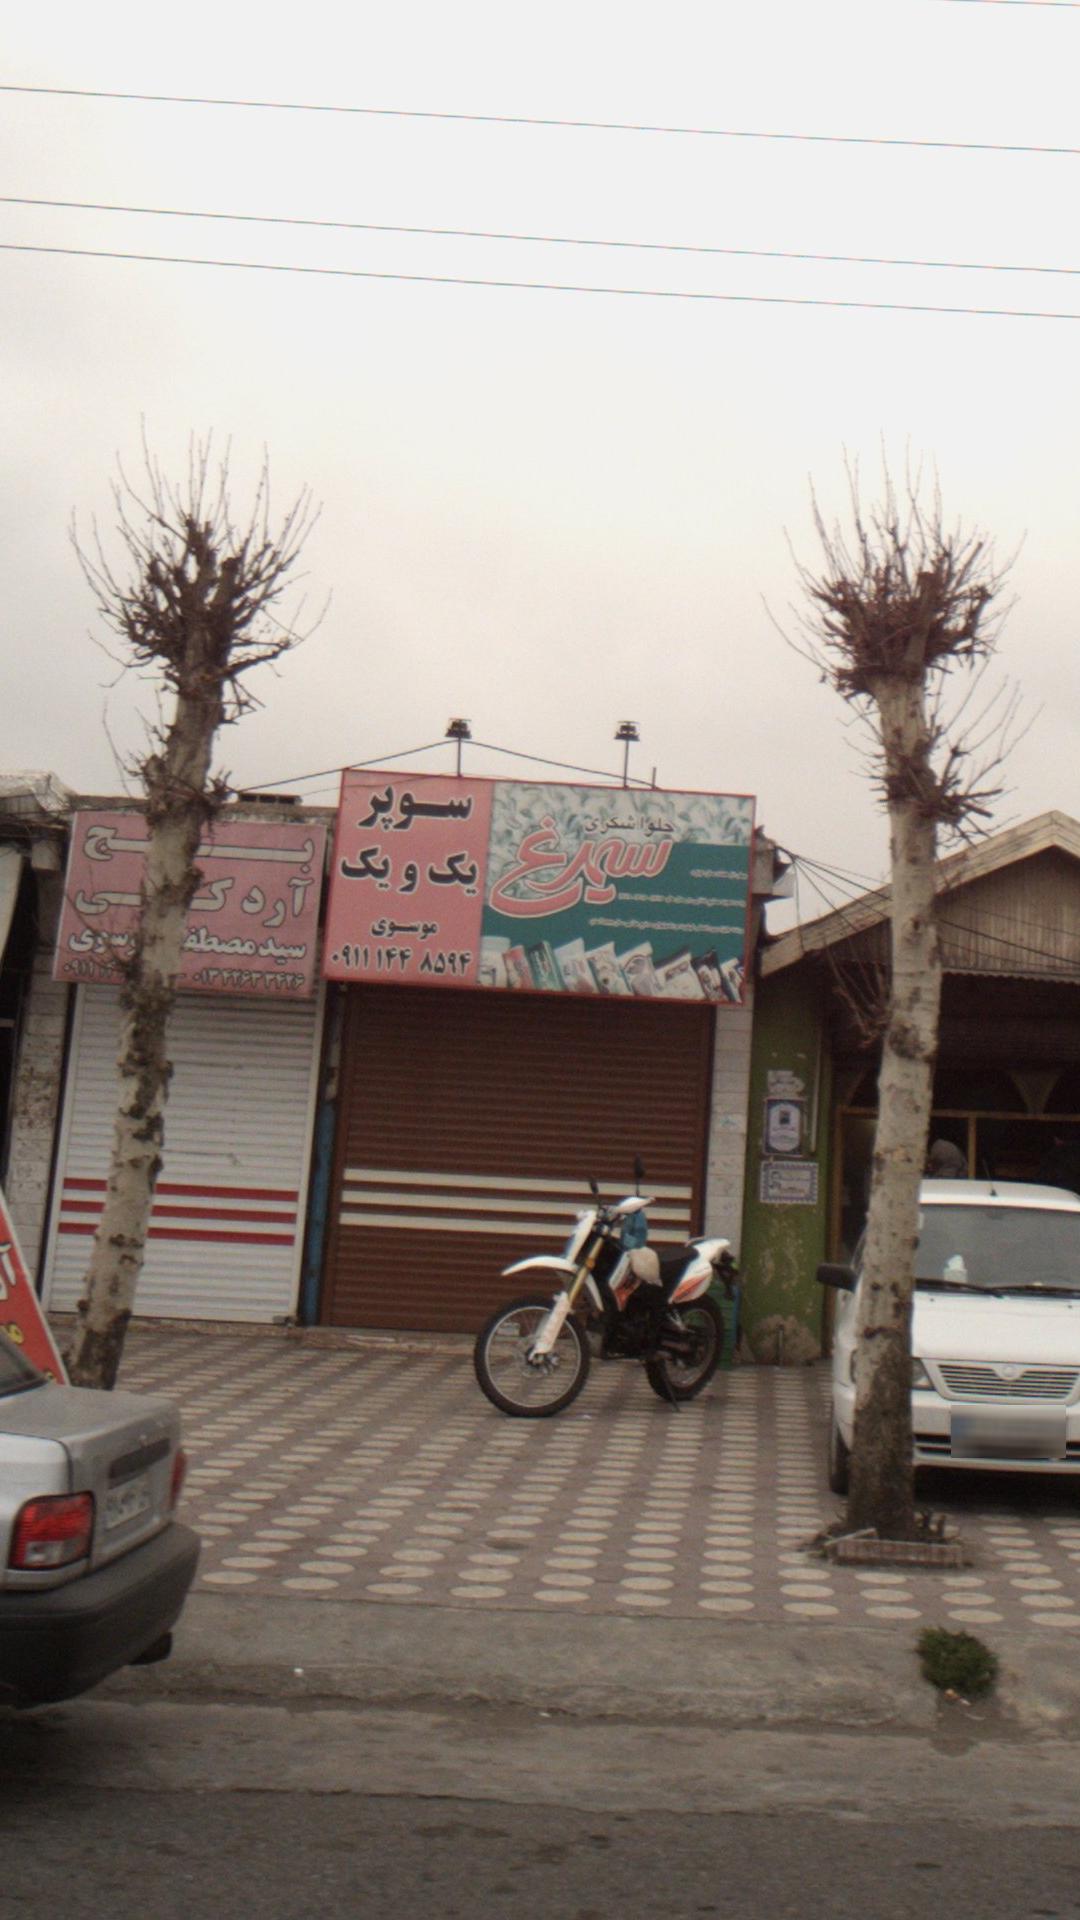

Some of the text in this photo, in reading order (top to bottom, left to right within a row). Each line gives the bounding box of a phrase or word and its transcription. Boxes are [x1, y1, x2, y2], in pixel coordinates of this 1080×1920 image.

[358, 785, 473, 830] سوپر
[341, 845, 478, 895] یک و یک
[488, 816, 674, 918] سیمرغ
[184, 927, 255, 956] مصطف
[371, 918, 438, 940] موسوی
[258, 932, 306, 964] سید
[332, 945, 369, 969] ۰۹۱۱
[377, 947, 411, 968] ۱۴۴
[420, 952, 473, 975] ۸۵۹۴
